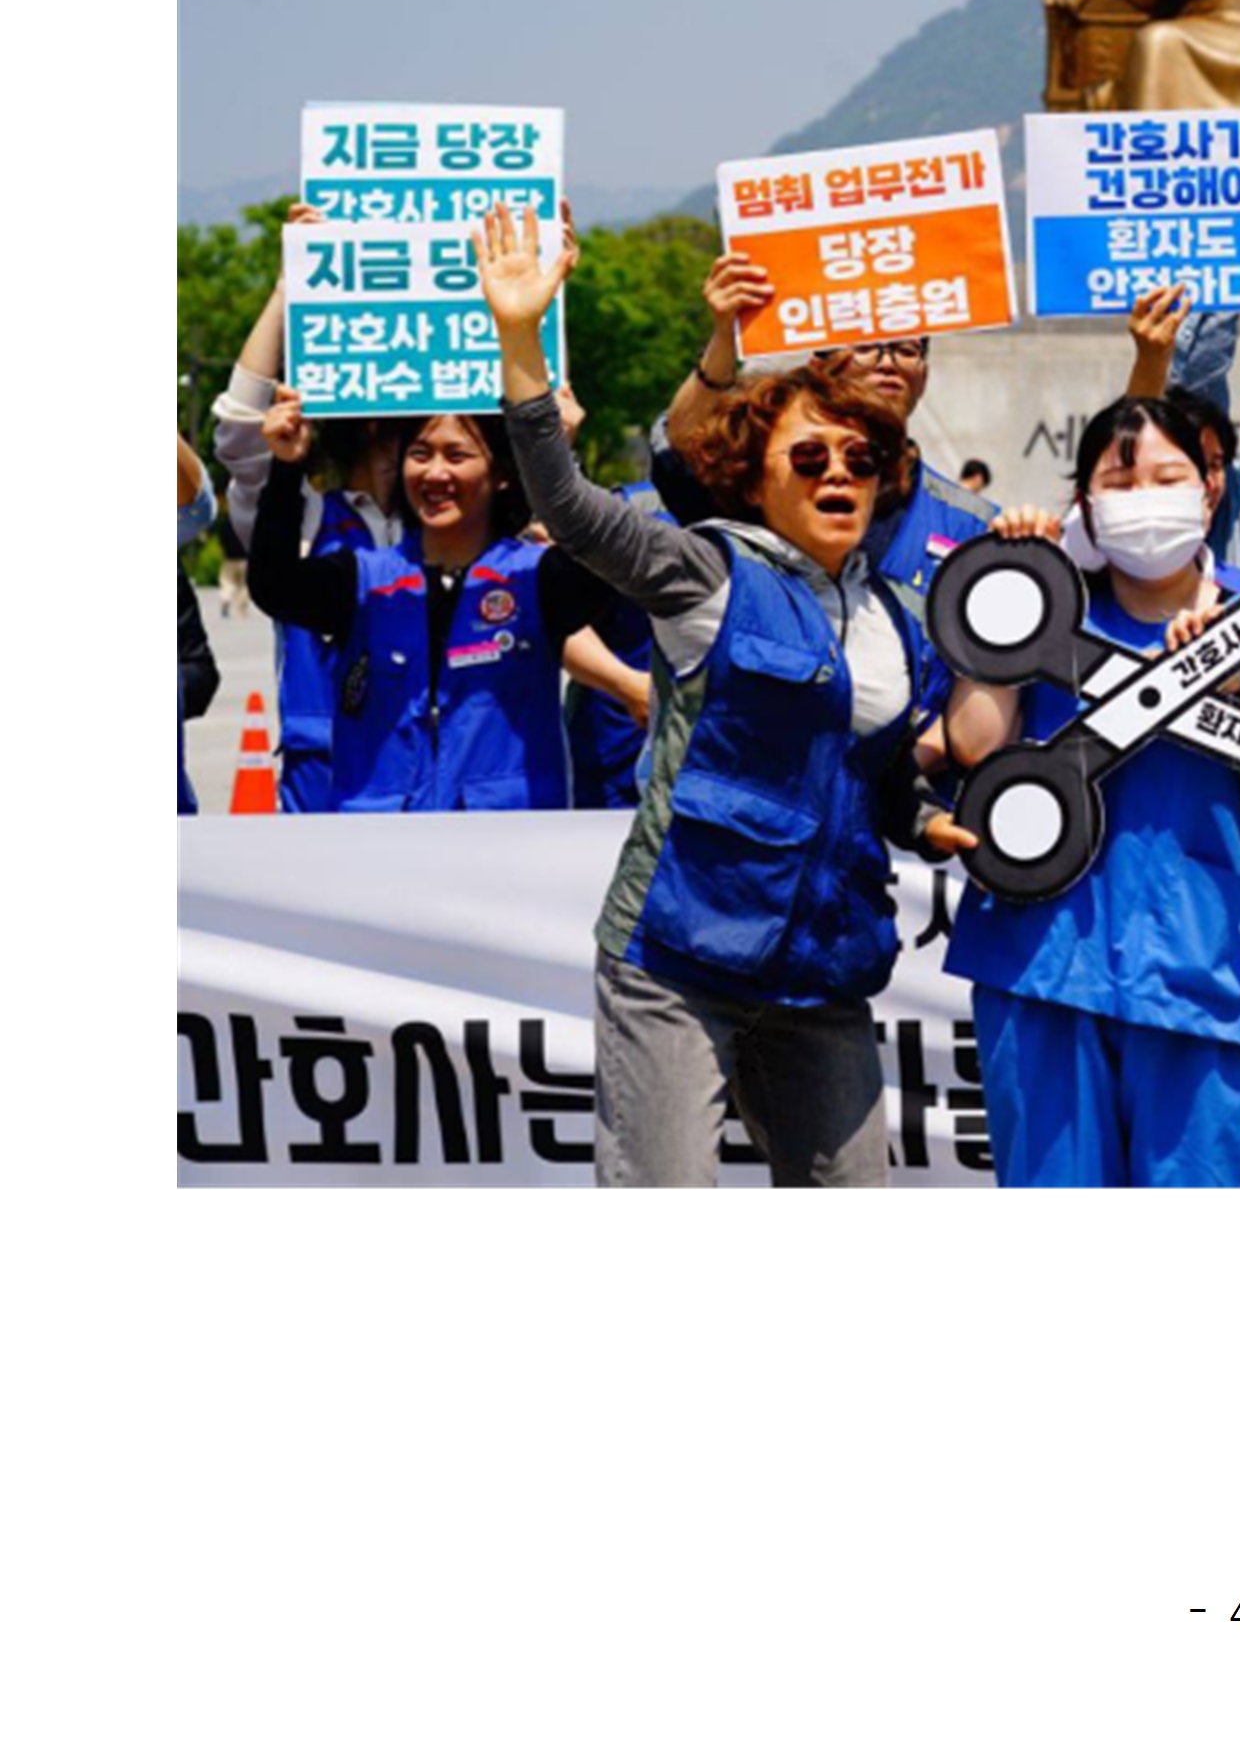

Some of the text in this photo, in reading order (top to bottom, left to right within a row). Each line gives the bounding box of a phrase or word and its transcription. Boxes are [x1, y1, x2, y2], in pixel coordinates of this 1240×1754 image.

[321, 123, 540, 170] 지금 당장
[315, 189, 438, 222] 간호사
[733, 150, 986, 219] 멈춰 업무전가
[818, 225, 916, 280] 당장
[1107, 217, 1238, 262] 환자도
[306, 240, 411, 291] 지금
[303, 312, 433, 354] 간호사
[777, 276, 971, 345] 인력충원
[296, 361, 421, 402] 환자수
